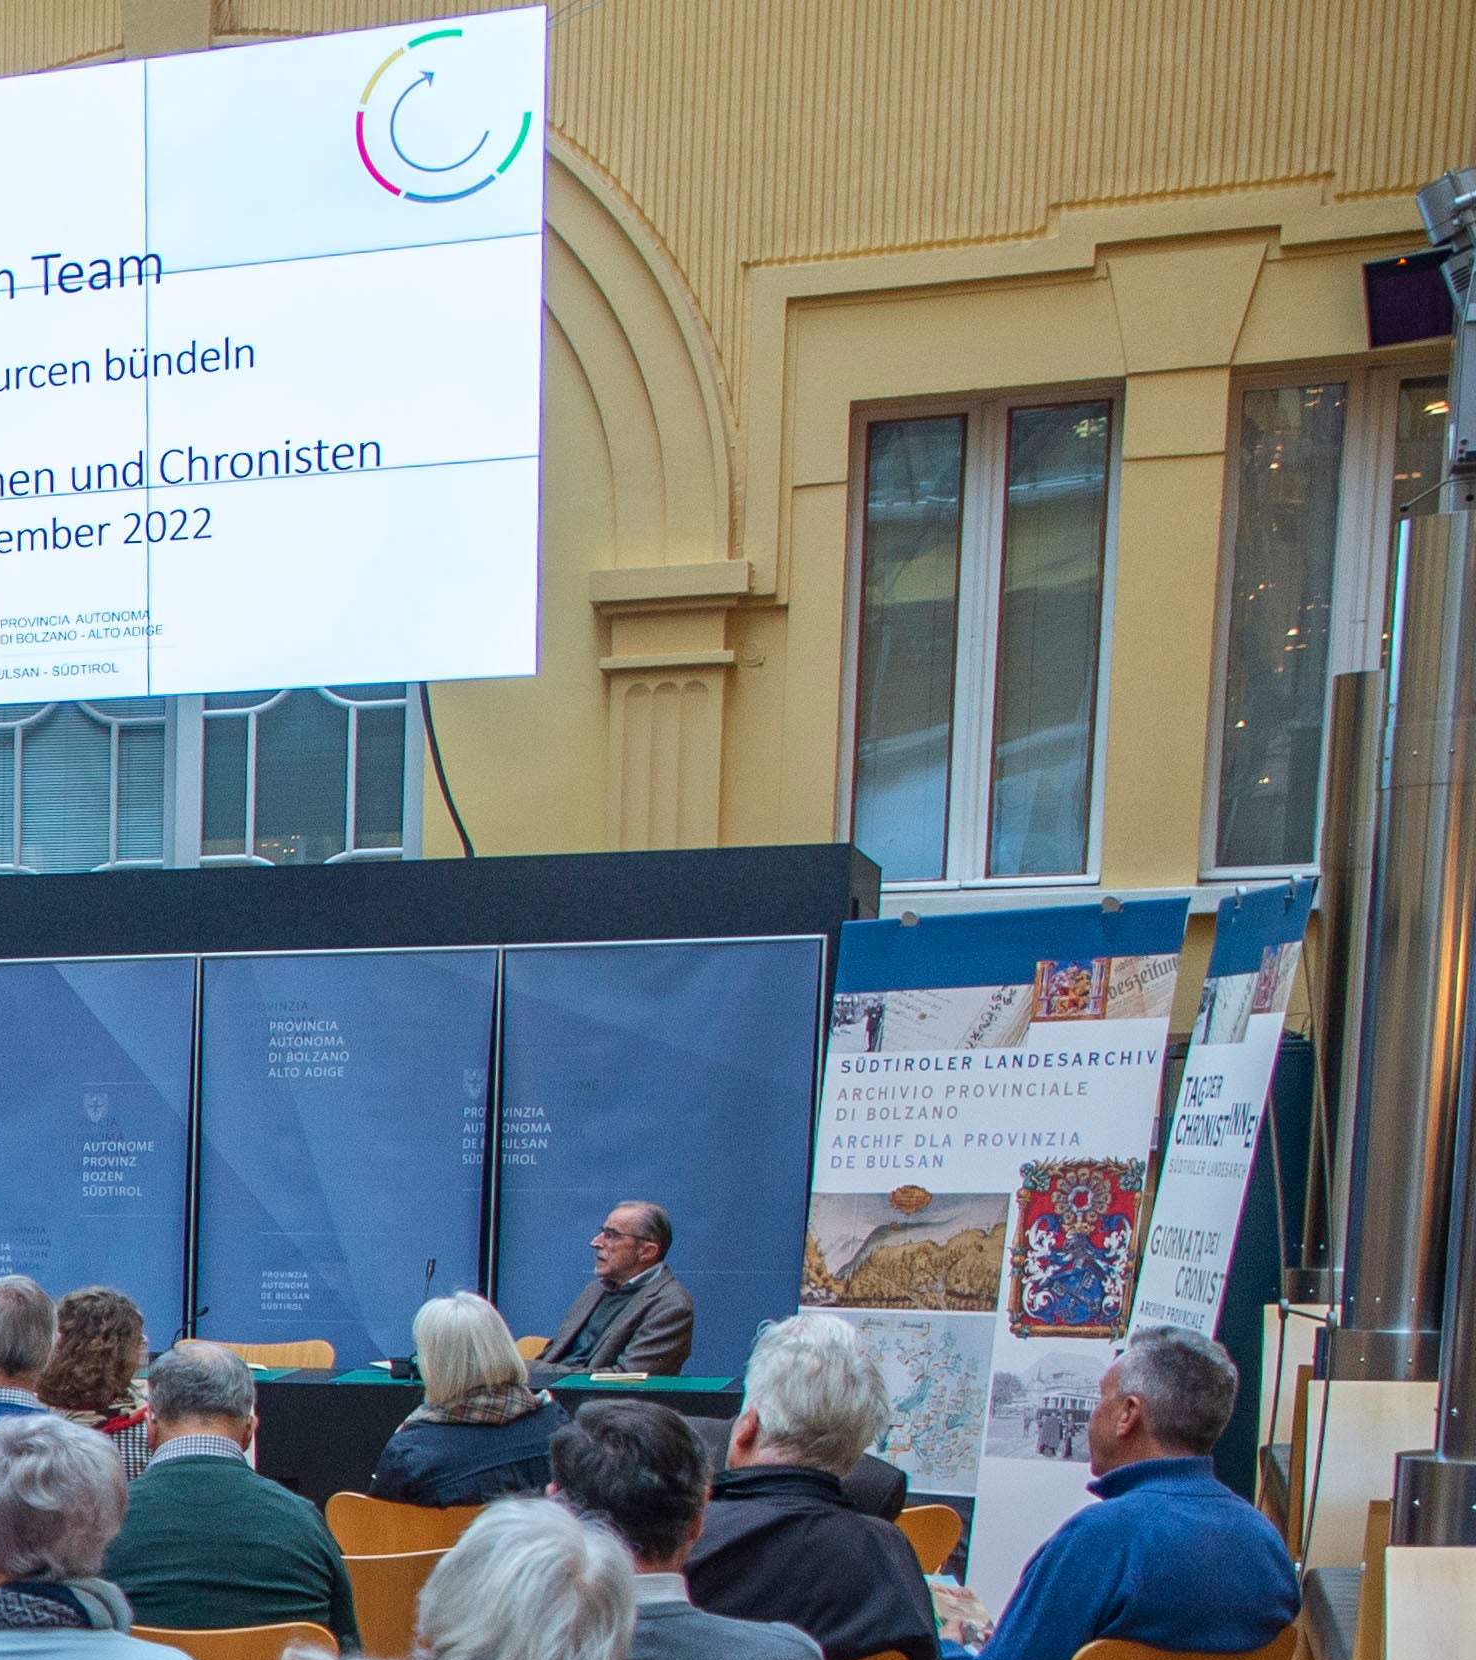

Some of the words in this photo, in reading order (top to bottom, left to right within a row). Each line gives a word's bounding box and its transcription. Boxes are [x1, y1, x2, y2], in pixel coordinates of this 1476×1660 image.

[31, 251, 163, 297] Team
[105, 336, 255, 382] bündeln
[71, 450, 144, 492] und
[159, 440, 381, 485] Chronisten
[123, 507, 212, 545] 2022
[0, 614, 71, 629] PROVINCIA
[75, 609, 150, 626] AUTONOMA
[0, 633, 13, 646] DI
[15, 629, 77, 644] BOLZANO
[87, 626, 120, 641] ALTO
[123, 624, 164, 638] ADIGE
[51, 662, 119, 678] SÜDTIROL
[269, 1021, 339, 1032] PROVINCIA
[268, 1036, 345, 1047] AUTONOMA
[268, 1051, 281, 1063] DI
[286, 1051, 350, 1062] BOLZANO
[840, 1055, 973, 1074] SÜDTIROLER
[984, 1049, 1158, 1070] LANDESARCHIV
[267, 1067, 301, 1078] ALTO
[304, 1066, 345, 1078] ADIGE
[836, 1085, 934, 1102] ARCHIVIO
[944, 1081, 1090, 1099] PROVINCIALE
[835, 1107, 857, 1122] DI
[866, 1105, 959, 1121] BOLZANO
[82, 1140, 155, 1152] AUTONOME
[831, 1134, 904, 1149] ARCHIF
[914, 1132, 953, 1148] DLA
[963, 1131, 1082, 1148] PROVINZIA
[82, 1156, 138, 1167] PROVINZ
[830, 1155, 857, 1169] DE
[866, 1154, 944, 1169] BULSAN
[82, 1171, 123, 1182] BOZEN
[81, 1184, 144, 1198] SÜDTIROL
[261, 1271, 308, 1279] PROVINZIA
[260, 1281, 310, 1290] AUTONOMA
